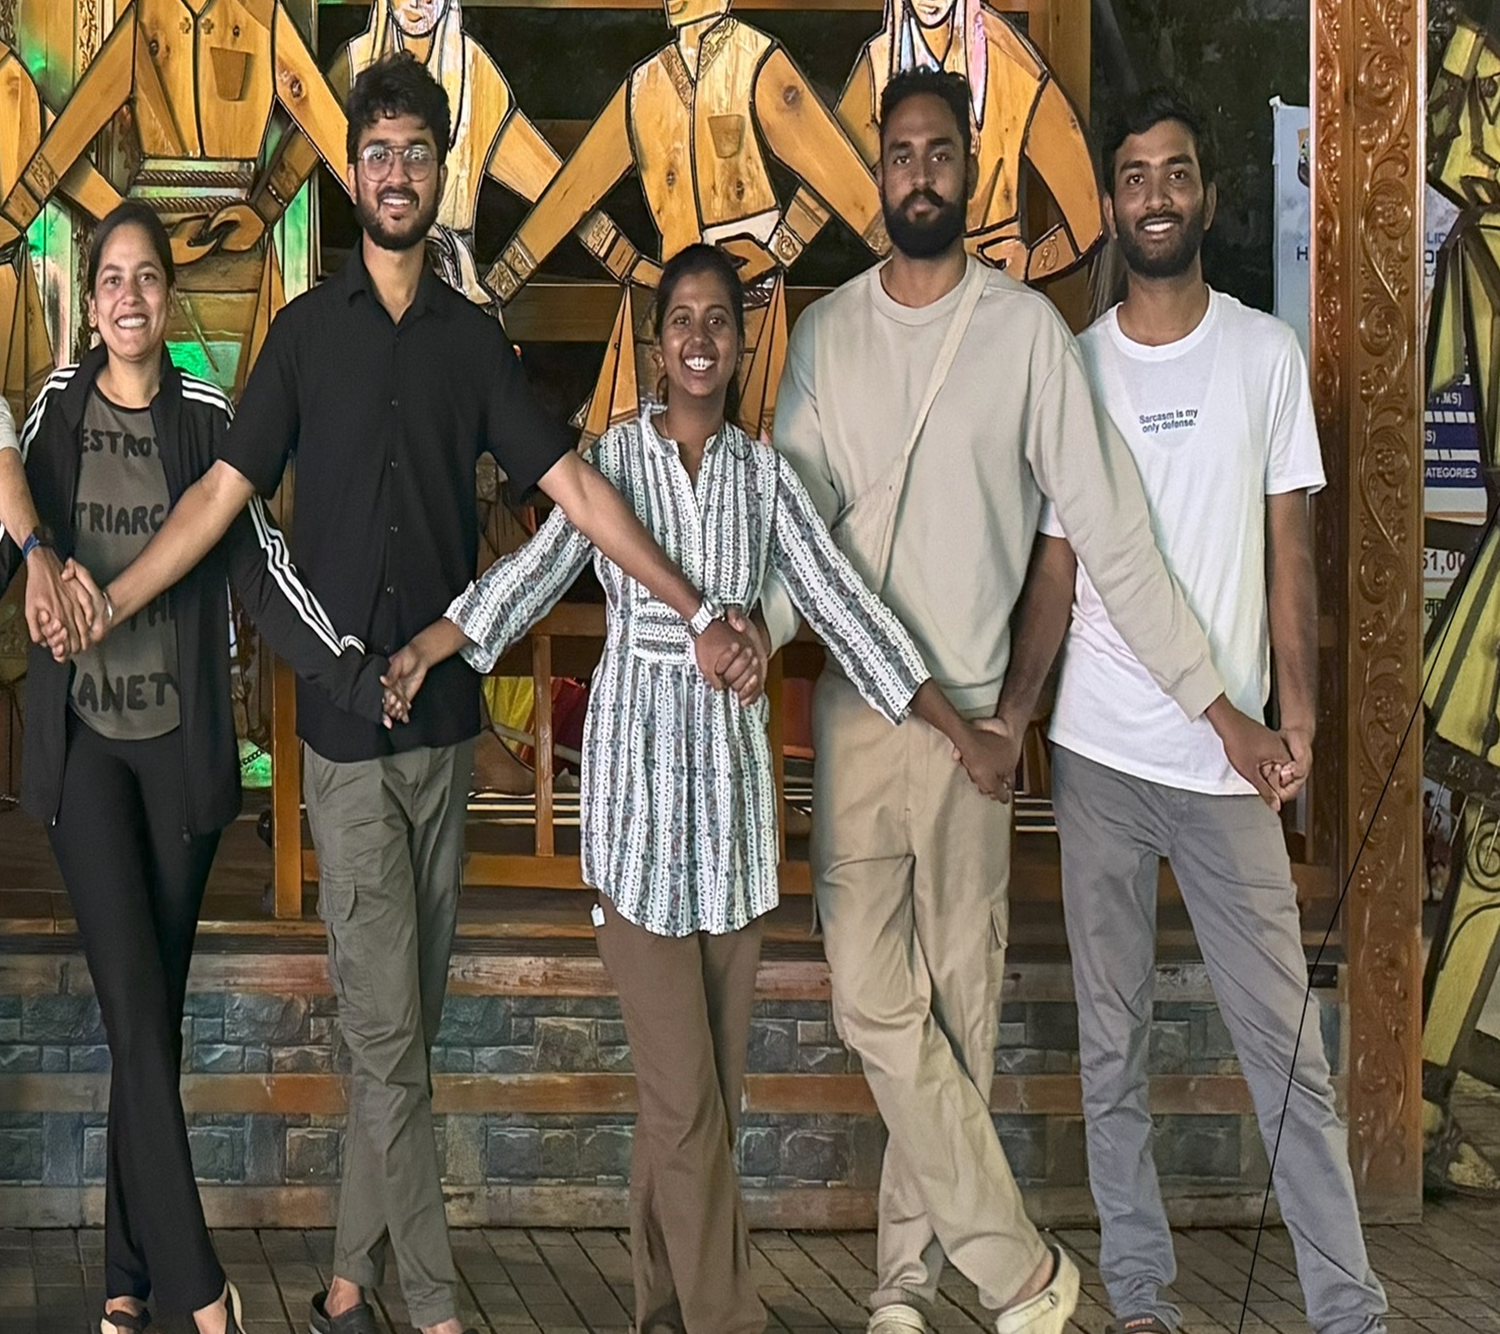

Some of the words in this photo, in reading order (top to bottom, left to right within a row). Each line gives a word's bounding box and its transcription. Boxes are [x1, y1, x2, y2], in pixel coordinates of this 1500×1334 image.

[1139, 412, 1175, 425] Sarcasm
[1175, 409, 1184, 418] is
[1185, 409, 1198, 419] my
[1142, 422, 1160, 433] only
[1161, 418, 1197, 430] defense.
[81, 428, 161, 459] ESTRO
[1425, 467, 1477, 478] ATEGORIES
[76, 501, 165, 536] TRIARC
[77, 672, 177, 714] ANET
